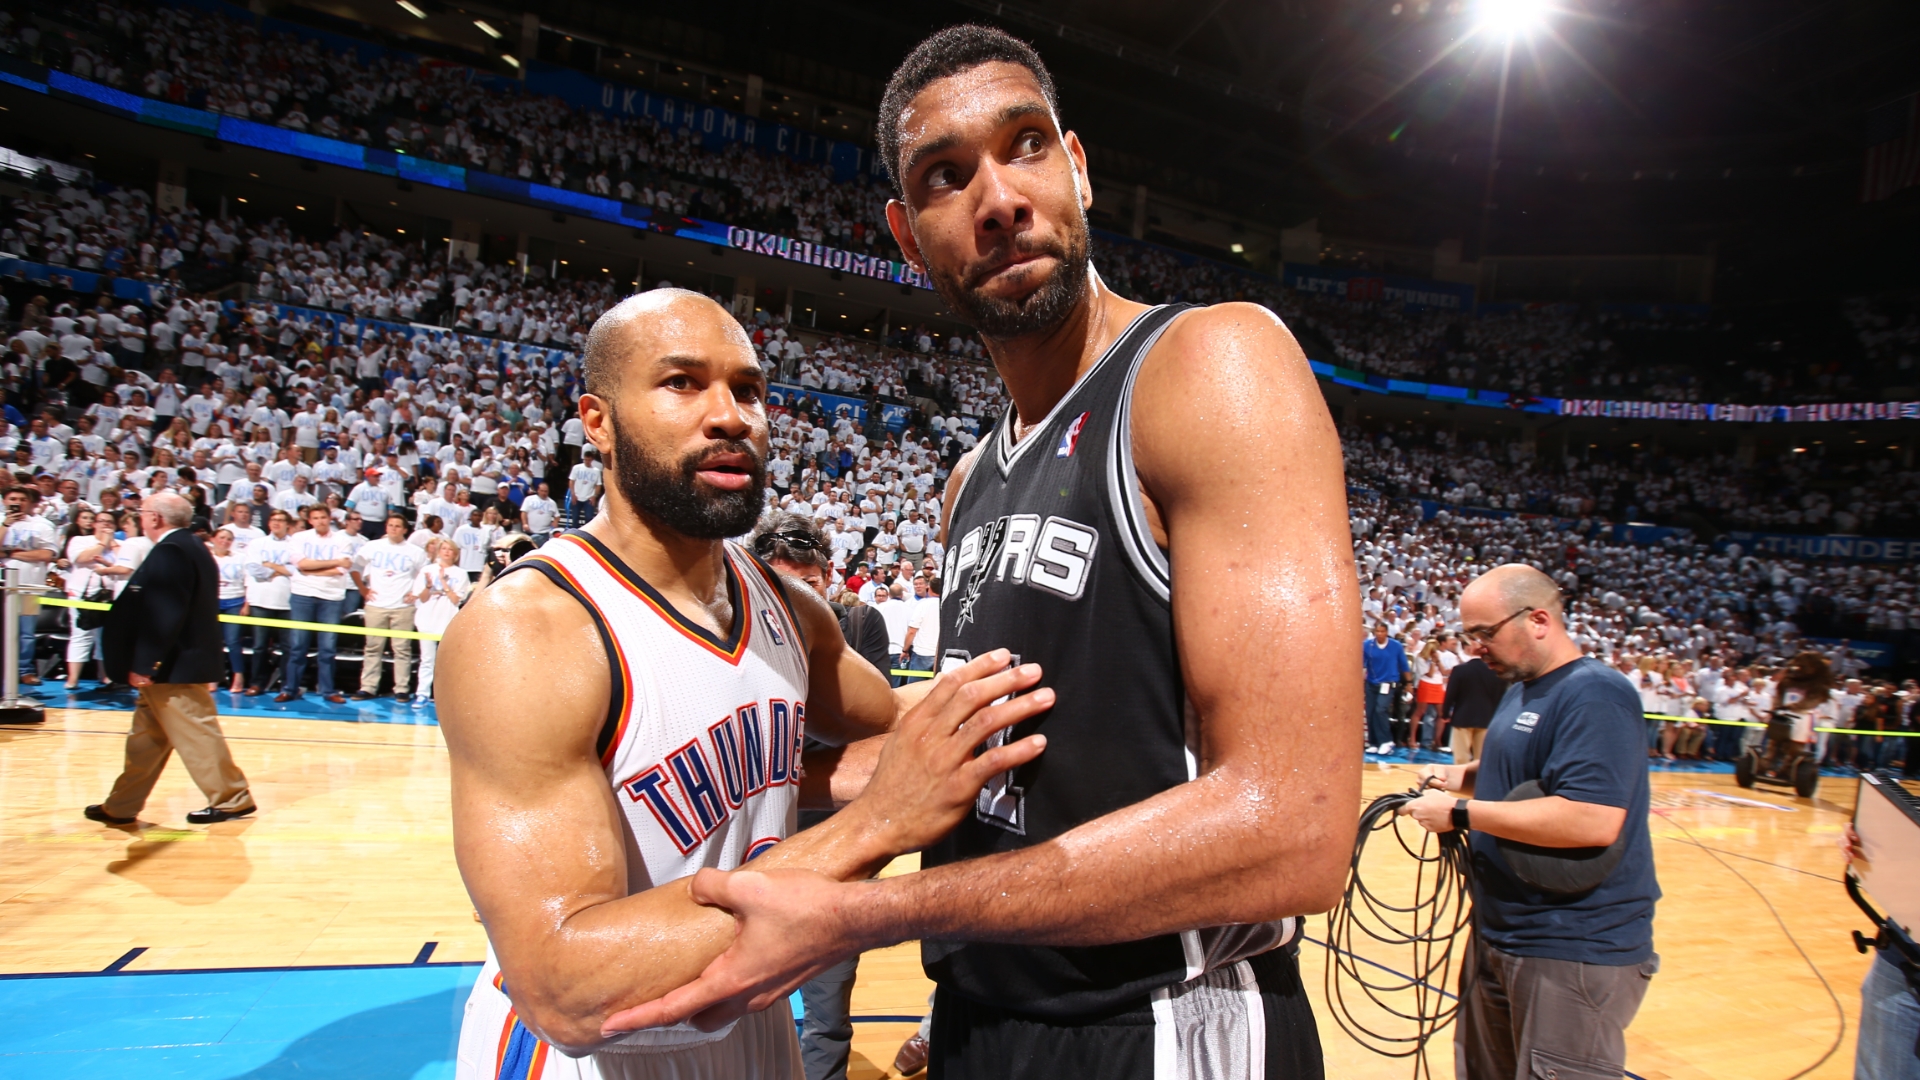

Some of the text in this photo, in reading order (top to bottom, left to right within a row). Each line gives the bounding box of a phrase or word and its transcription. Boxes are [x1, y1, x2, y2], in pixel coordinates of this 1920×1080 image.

[601, 82, 756, 144] OKLAHOMA
[777, 127, 835, 163] CITY
[727, 225, 892, 281] OKLAHOMA
[1347, 277, 1384, 302] GO
[1384, 287, 1460, 308] THUNDER
[372, 551, 413, 572] OKC
